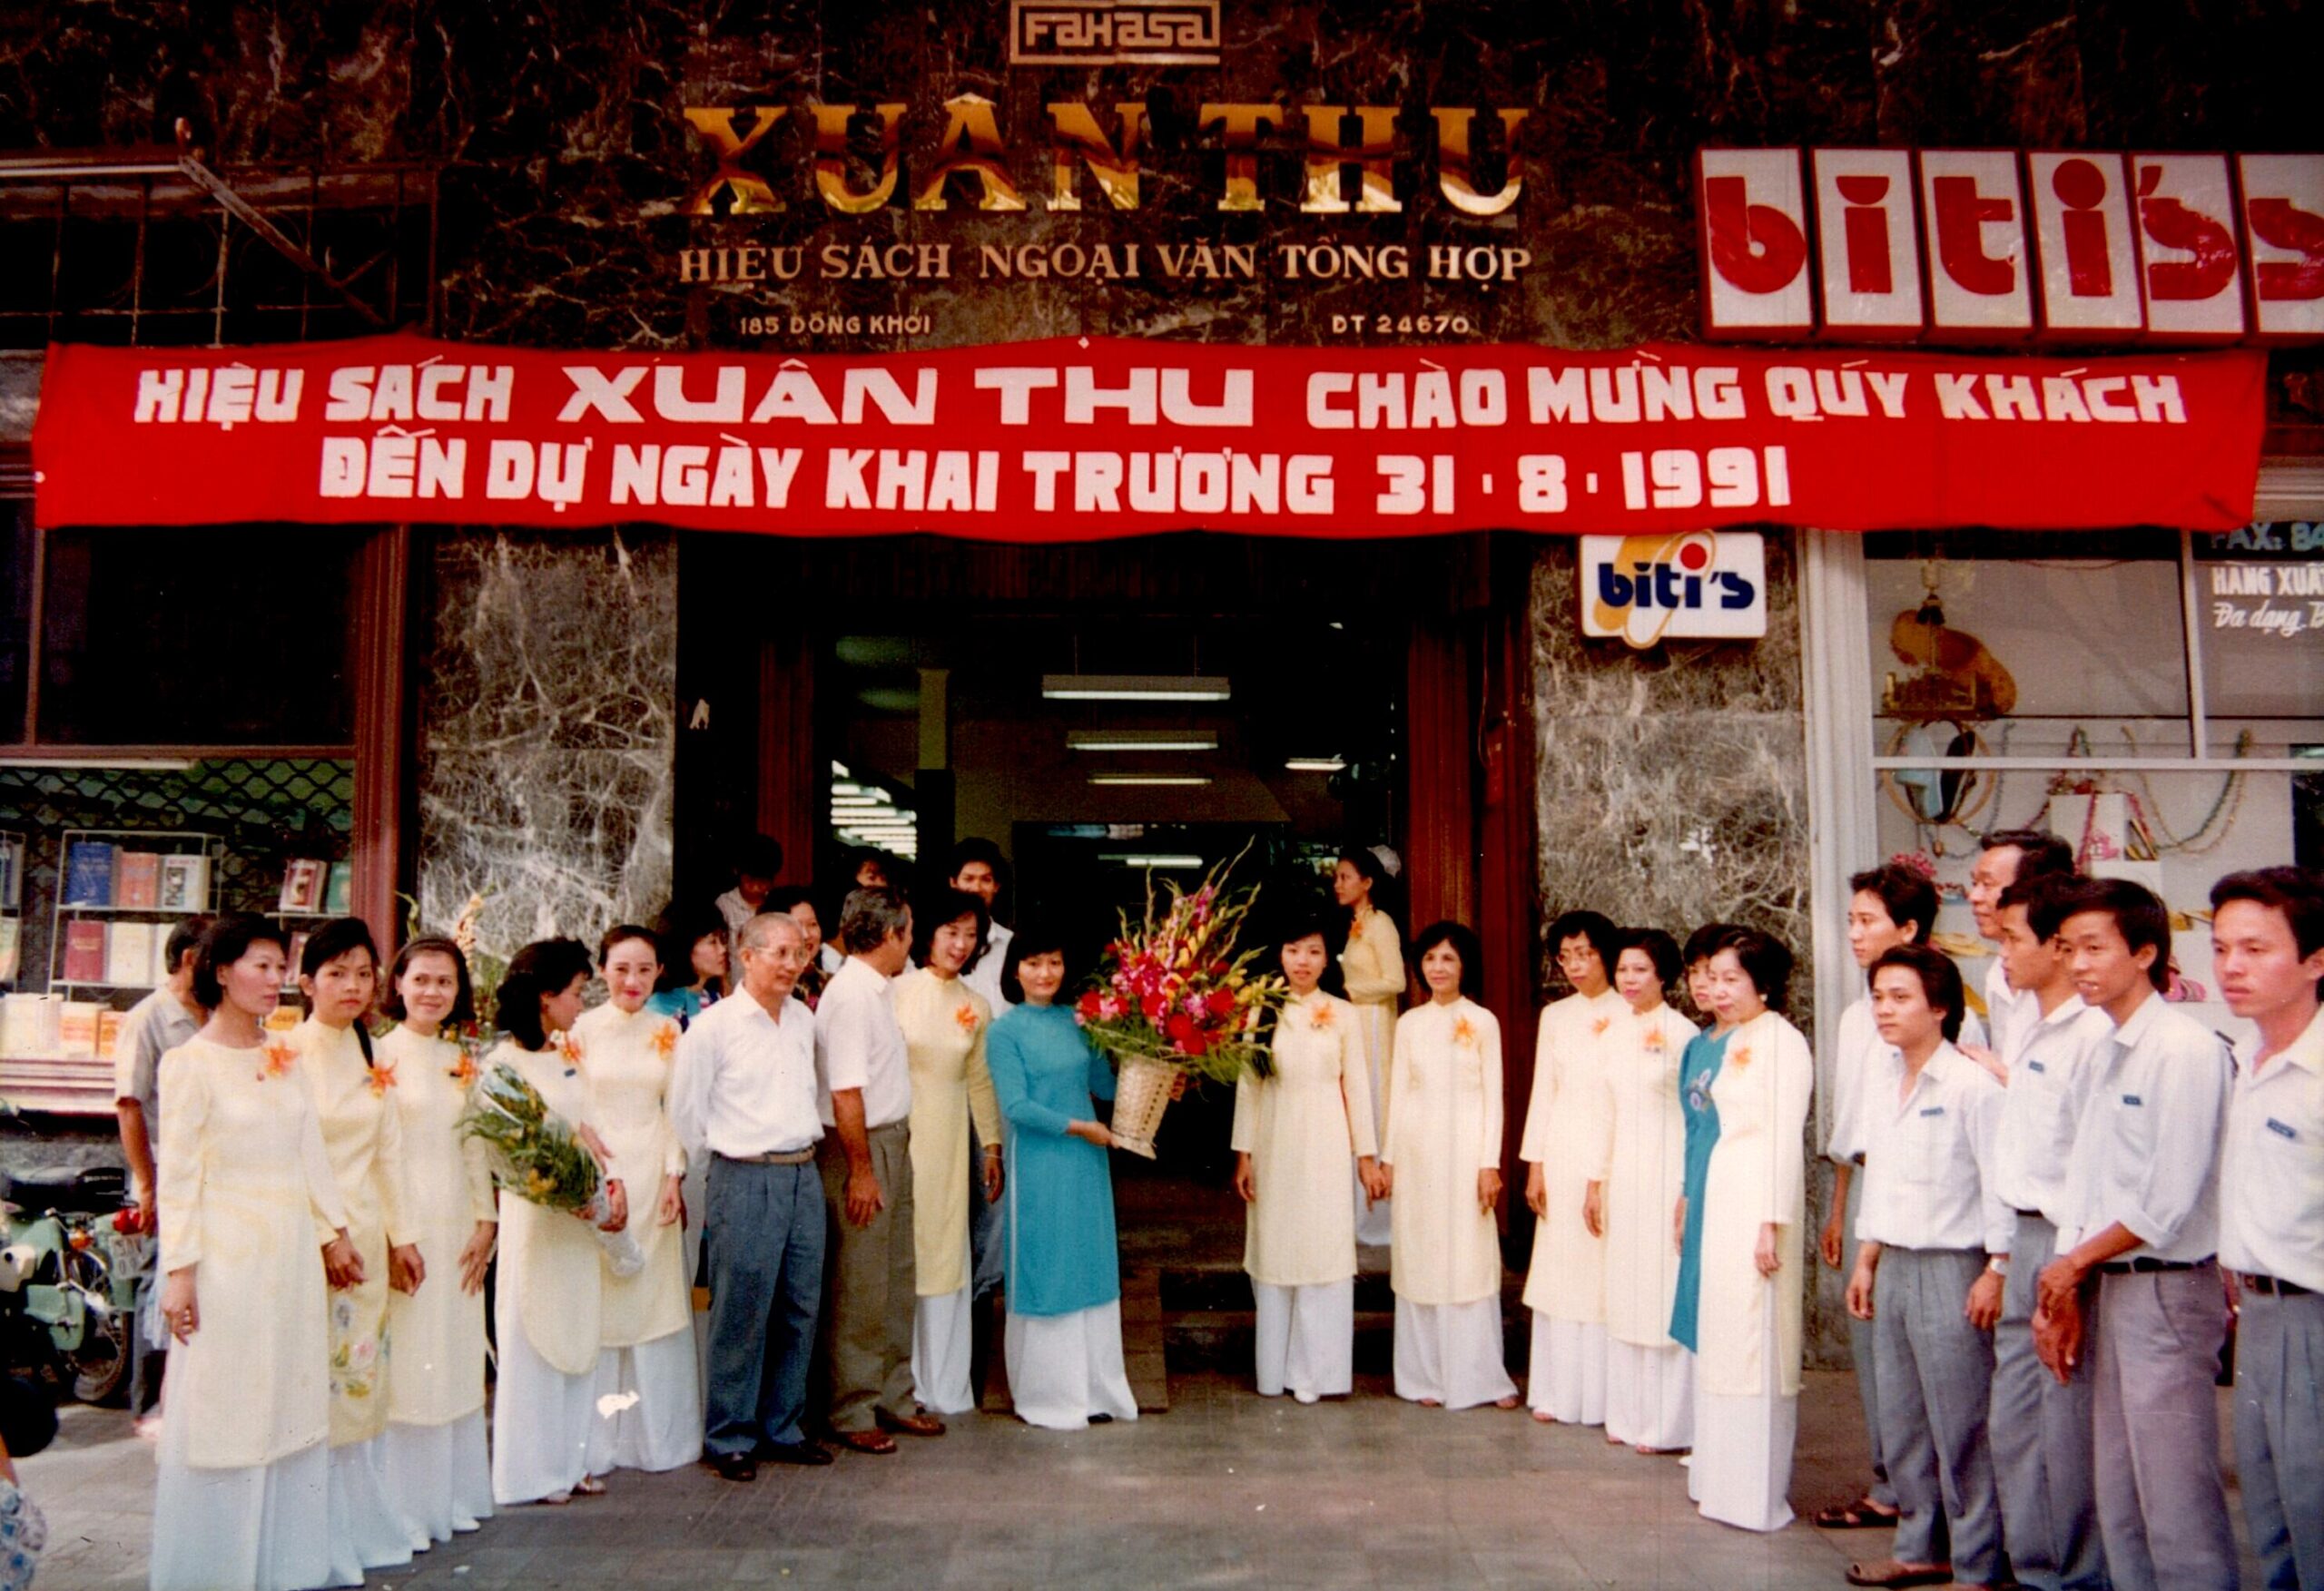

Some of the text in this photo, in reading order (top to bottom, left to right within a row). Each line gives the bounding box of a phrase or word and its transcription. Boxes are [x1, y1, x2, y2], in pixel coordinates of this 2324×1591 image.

[677, 92, 1529, 215] XUÂN THU
[821, 235, 950, 279] SÁCH
[980, 242, 1140, 285] NGOẠI
[1156, 237, 1256, 278] VĂN
[1428, 243, 1531, 291] HỢP
[740, 317, 780, 335] 185
[1376, 315, 1470, 334] 24670
[134, 361, 304, 430] HIỆU
[325, 355, 515, 422] SÁCH
[556, 358, 938, 425] XUÂN
[975, 366, 1254, 427] THU
[1306, 358, 1508, 429] CHÀO
[1527, 350, 1747, 424] MỪNG
[1935, 368, 2187, 423] KHÁCH
[320, 425, 467, 498] ĐẾN
[486, 437, 593, 512] DỰ
[610, 433, 803, 508] NGÀY
[825, 448, 1000, 511] KHAI
[1022, 447, 1334, 515] TRƯƠNG
[1598, 542, 1756, 609] biti's
